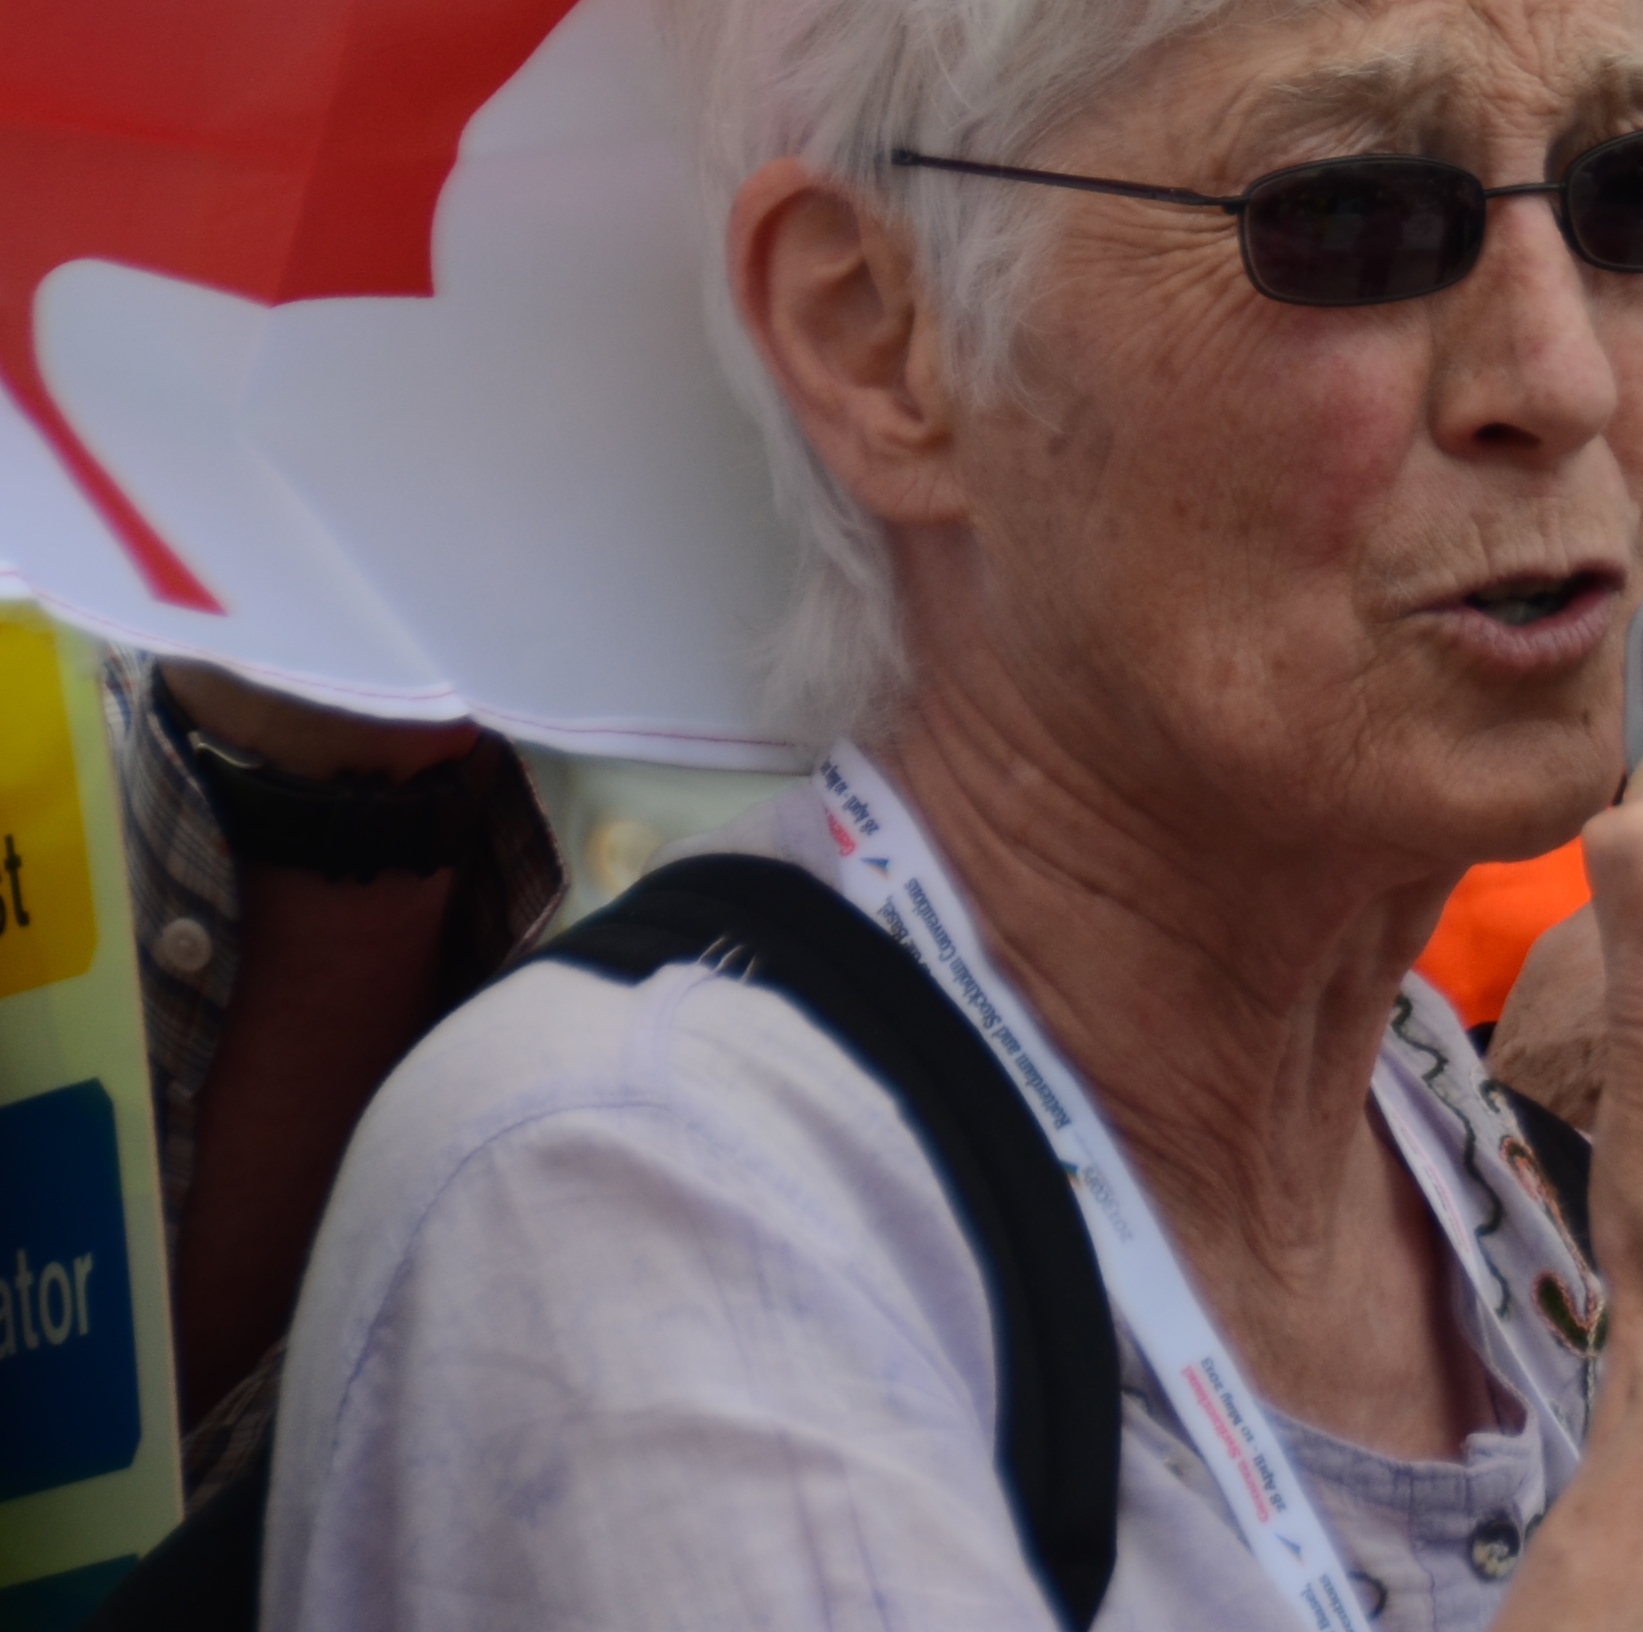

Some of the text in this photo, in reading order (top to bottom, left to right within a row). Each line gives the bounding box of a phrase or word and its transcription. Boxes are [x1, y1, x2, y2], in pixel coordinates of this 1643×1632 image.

[904, 877, 1072, 1130] Rotterdam and Stockholm Conventions
[1253, 1453, 1277, 1492] April
[1270, 1494, 1287, 1512] 28
